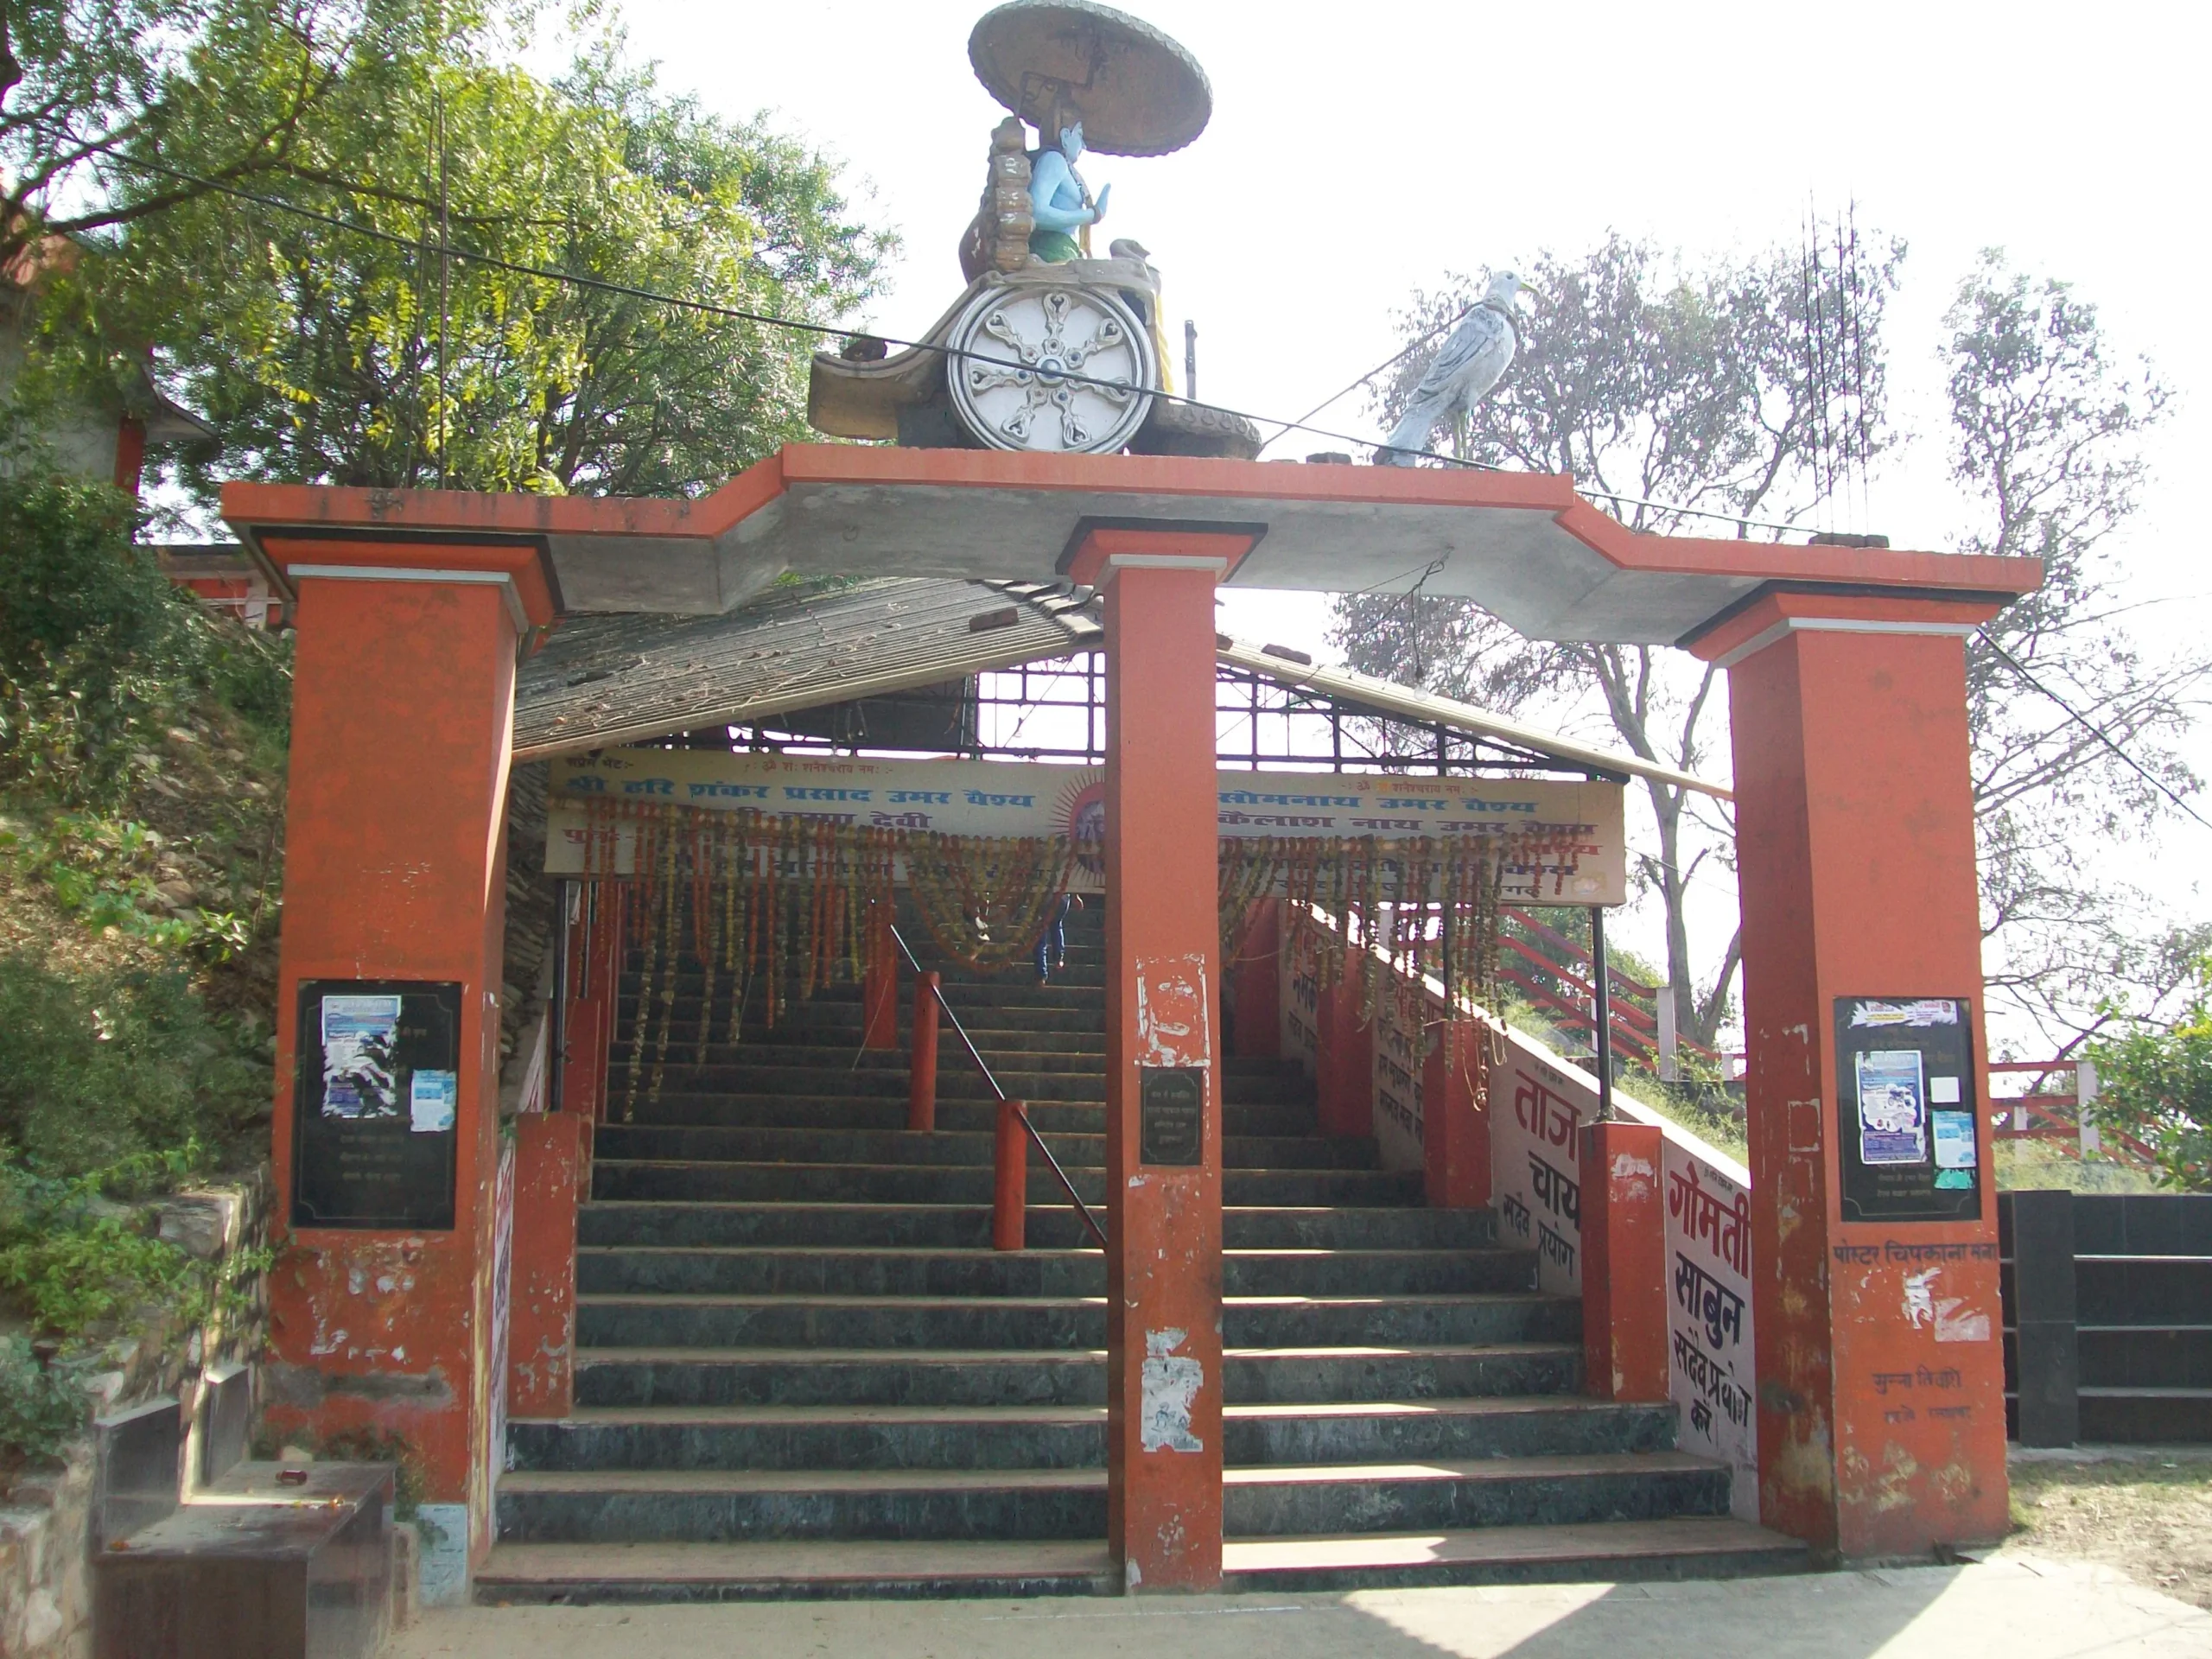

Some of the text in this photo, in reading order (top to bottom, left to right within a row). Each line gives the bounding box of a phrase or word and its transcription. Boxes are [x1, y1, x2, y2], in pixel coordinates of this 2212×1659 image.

[621, 778, 675, 795] हरि
[687, 781, 770, 799] शंकर
[783, 786, 874, 803] प्रसाद
[886, 790, 952, 804] उमर
[962, 789, 1036, 808] वैश्य
[1376, 798, 1449, 810] उमर
[1515, 1068, 1582, 1162] ताज
[1528, 1149, 1580, 1233] चाय
[1669, 1160, 1750, 1279] गोमती
[1675, 1250, 1745, 1350] साबुन
[1674, 1325, 1708, 1396] सदैव
